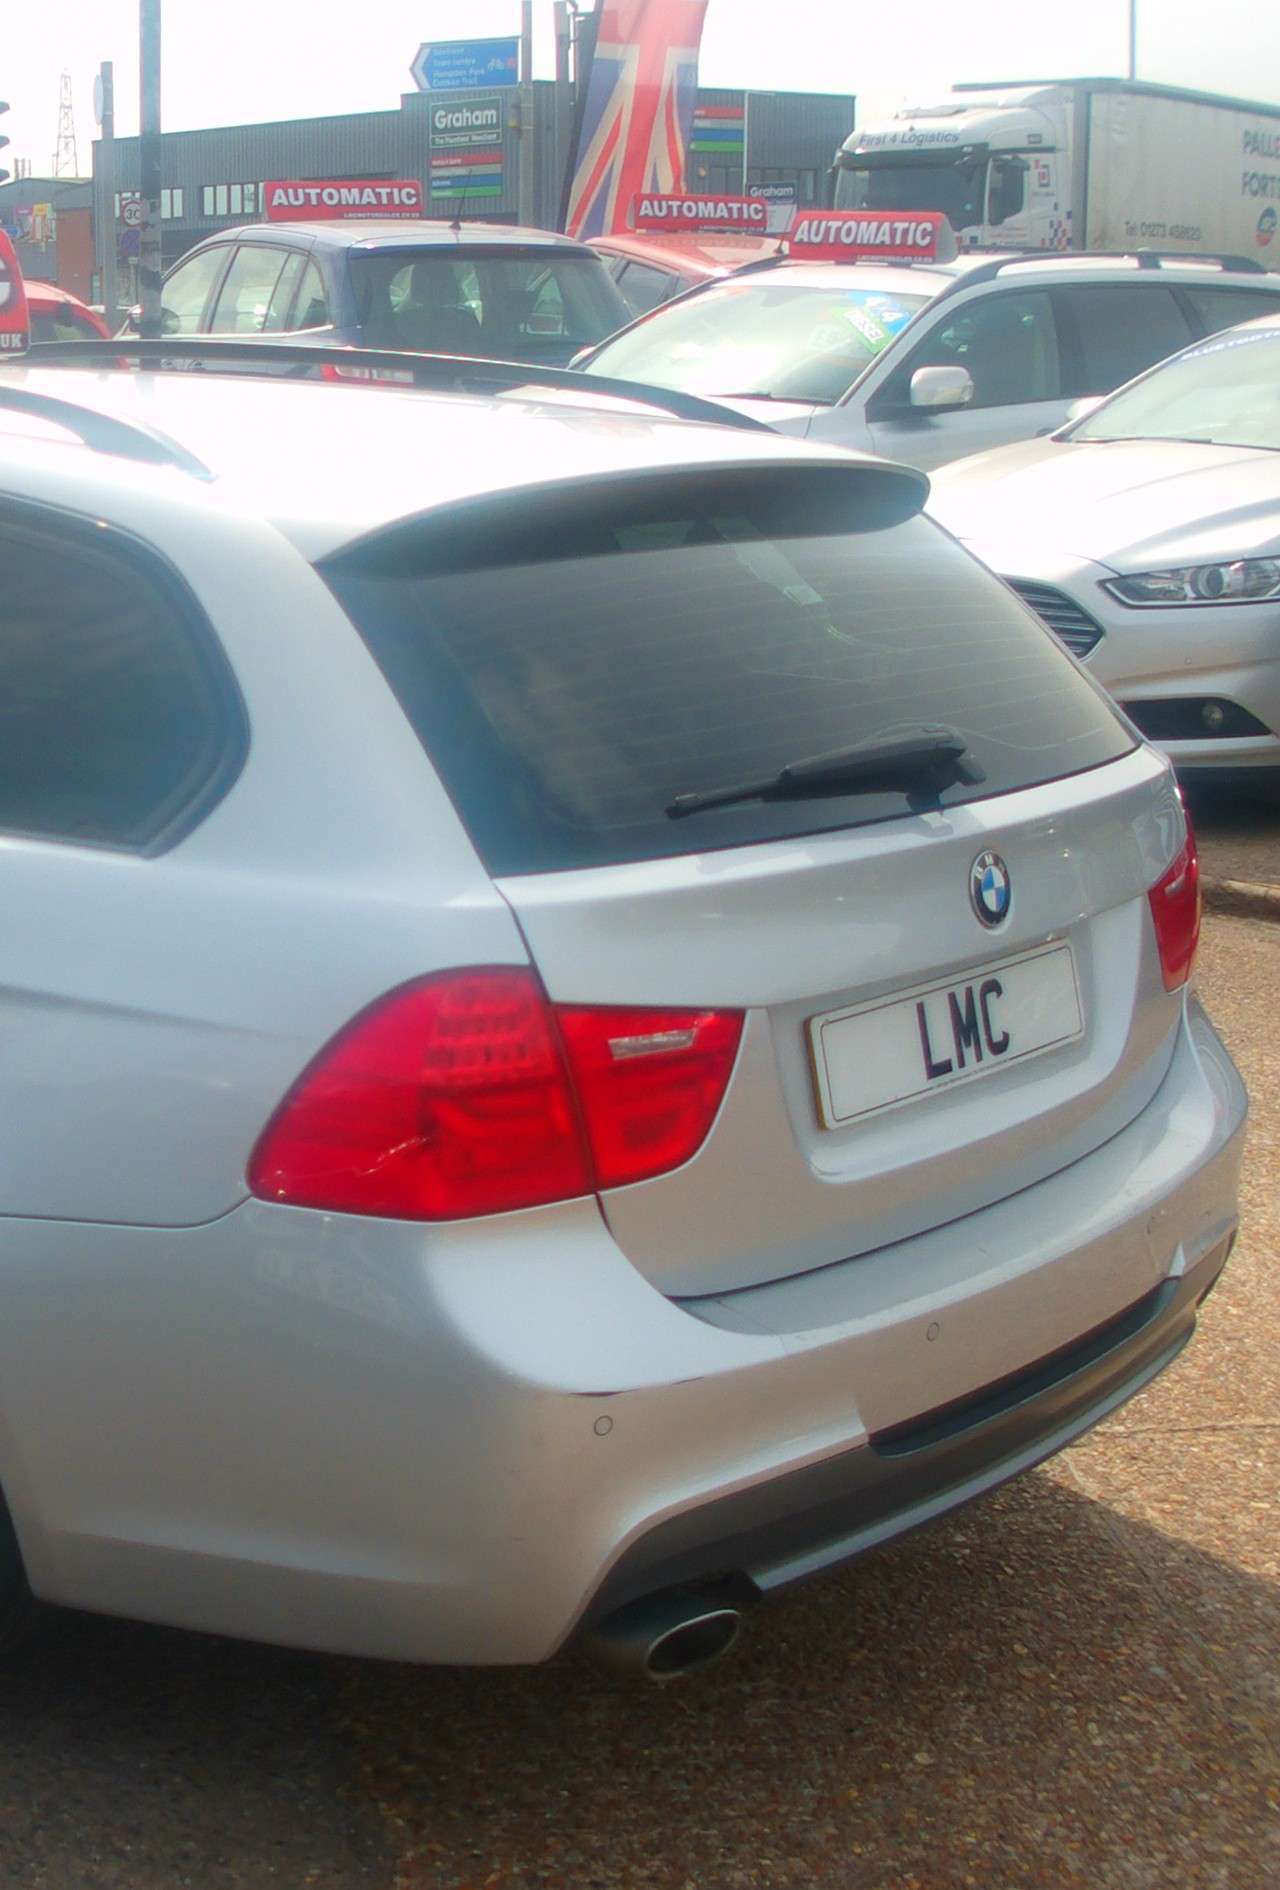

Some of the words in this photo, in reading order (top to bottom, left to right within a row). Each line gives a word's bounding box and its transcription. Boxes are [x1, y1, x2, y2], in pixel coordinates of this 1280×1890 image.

[434, 107, 497, 130] Graham
[859, 133, 886, 146] First
[889, 132, 899, 143] 4
[901, 131, 960, 146] Logistics
[271, 187, 417, 207] AUTOMATIC
[750, 186, 794, 198] Graham
[638, 199, 764, 220] AUTOMATIC
[794, 219, 934, 247] AUTOMATIC
[916, 977, 1010, 1082] LMC
